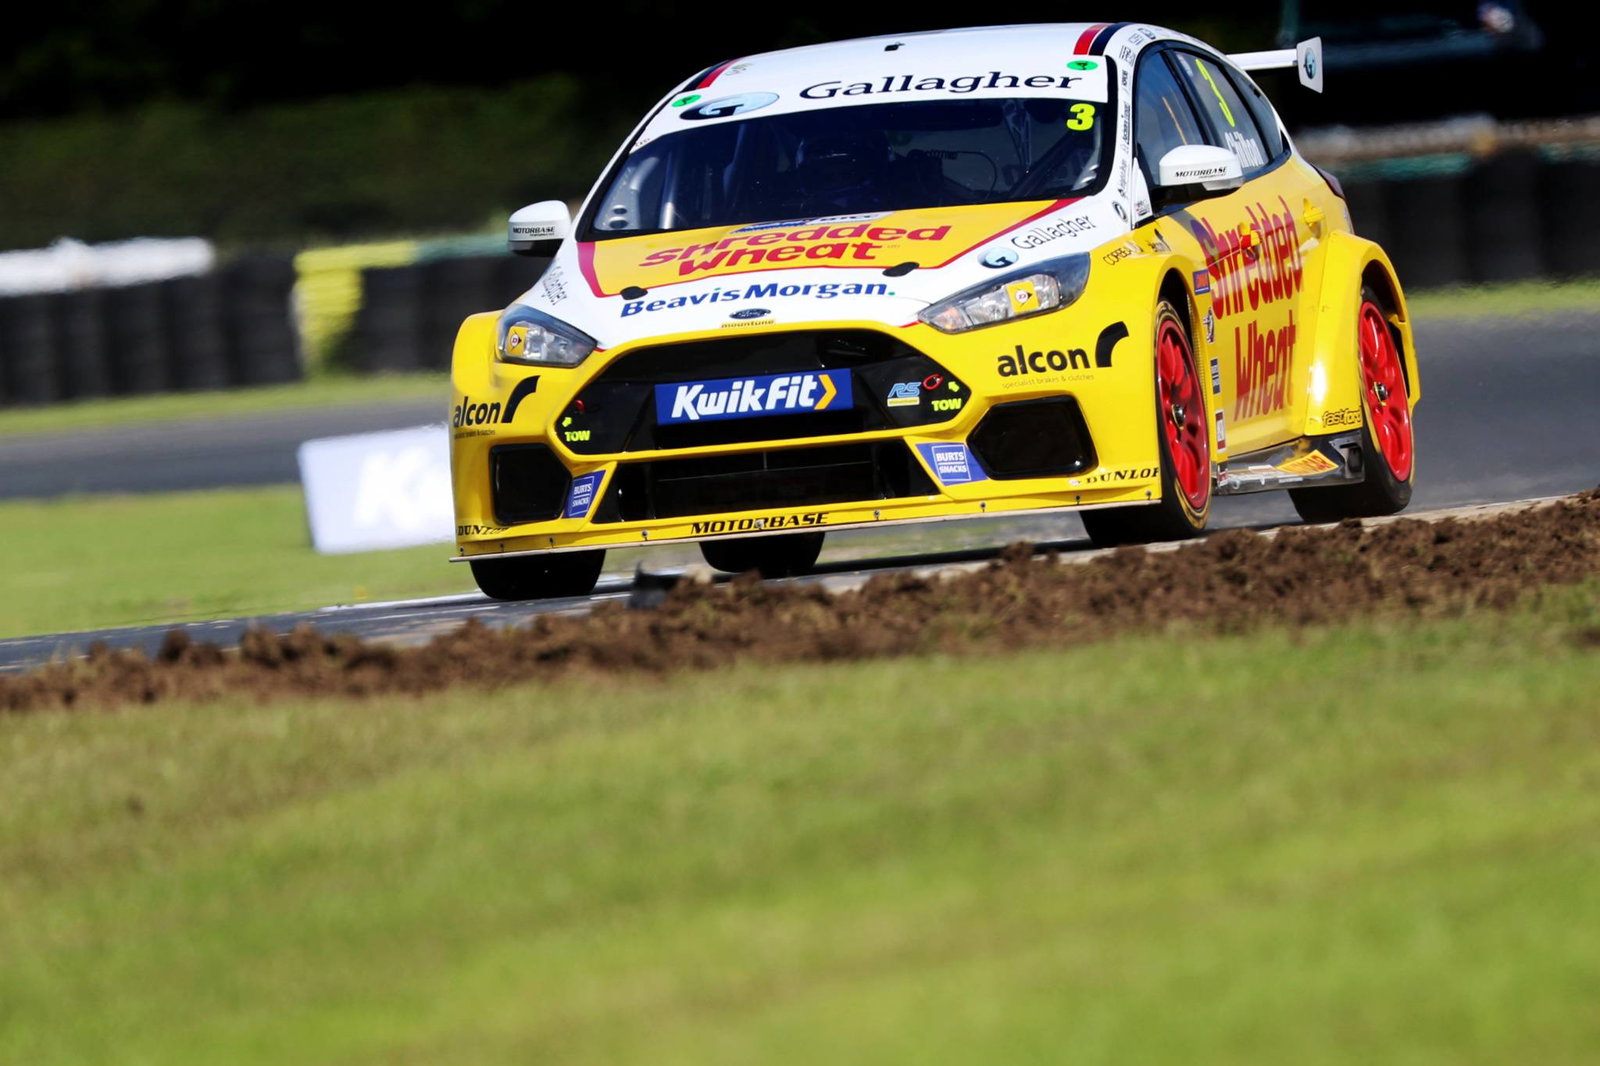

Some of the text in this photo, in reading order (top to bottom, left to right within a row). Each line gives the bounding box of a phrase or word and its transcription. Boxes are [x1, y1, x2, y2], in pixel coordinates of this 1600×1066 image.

[799, 72, 1082, 99] Gallagher
[1195, 59, 1235, 127] 3
[1066, 104, 1096, 131] 3
[1175, 166, 1227, 177] MOTORBASE
[513, 226, 555, 234] MOTORBASE
[1011, 214, 1097, 250] Gallagher
[639, 225, 952, 267] shredded
[1190, 195, 1303, 320] Shredded
[678, 242, 882, 276] wheat
[997, 345, 1090, 377] alcon
[1233, 309, 1297, 422] Wheat
[888, 382, 922, 398] RS
[453, 396, 501, 429] alcon
[931, 398, 961, 412] TOW
[564, 430, 591, 442] TOW
[936, 452, 965, 462] BURTS
[939, 465, 968, 474] SNACKS
[574, 483, 593, 495] BURTS
[572, 496, 591, 508] SNACKS
[691, 512, 830, 535] MOTORBASE
